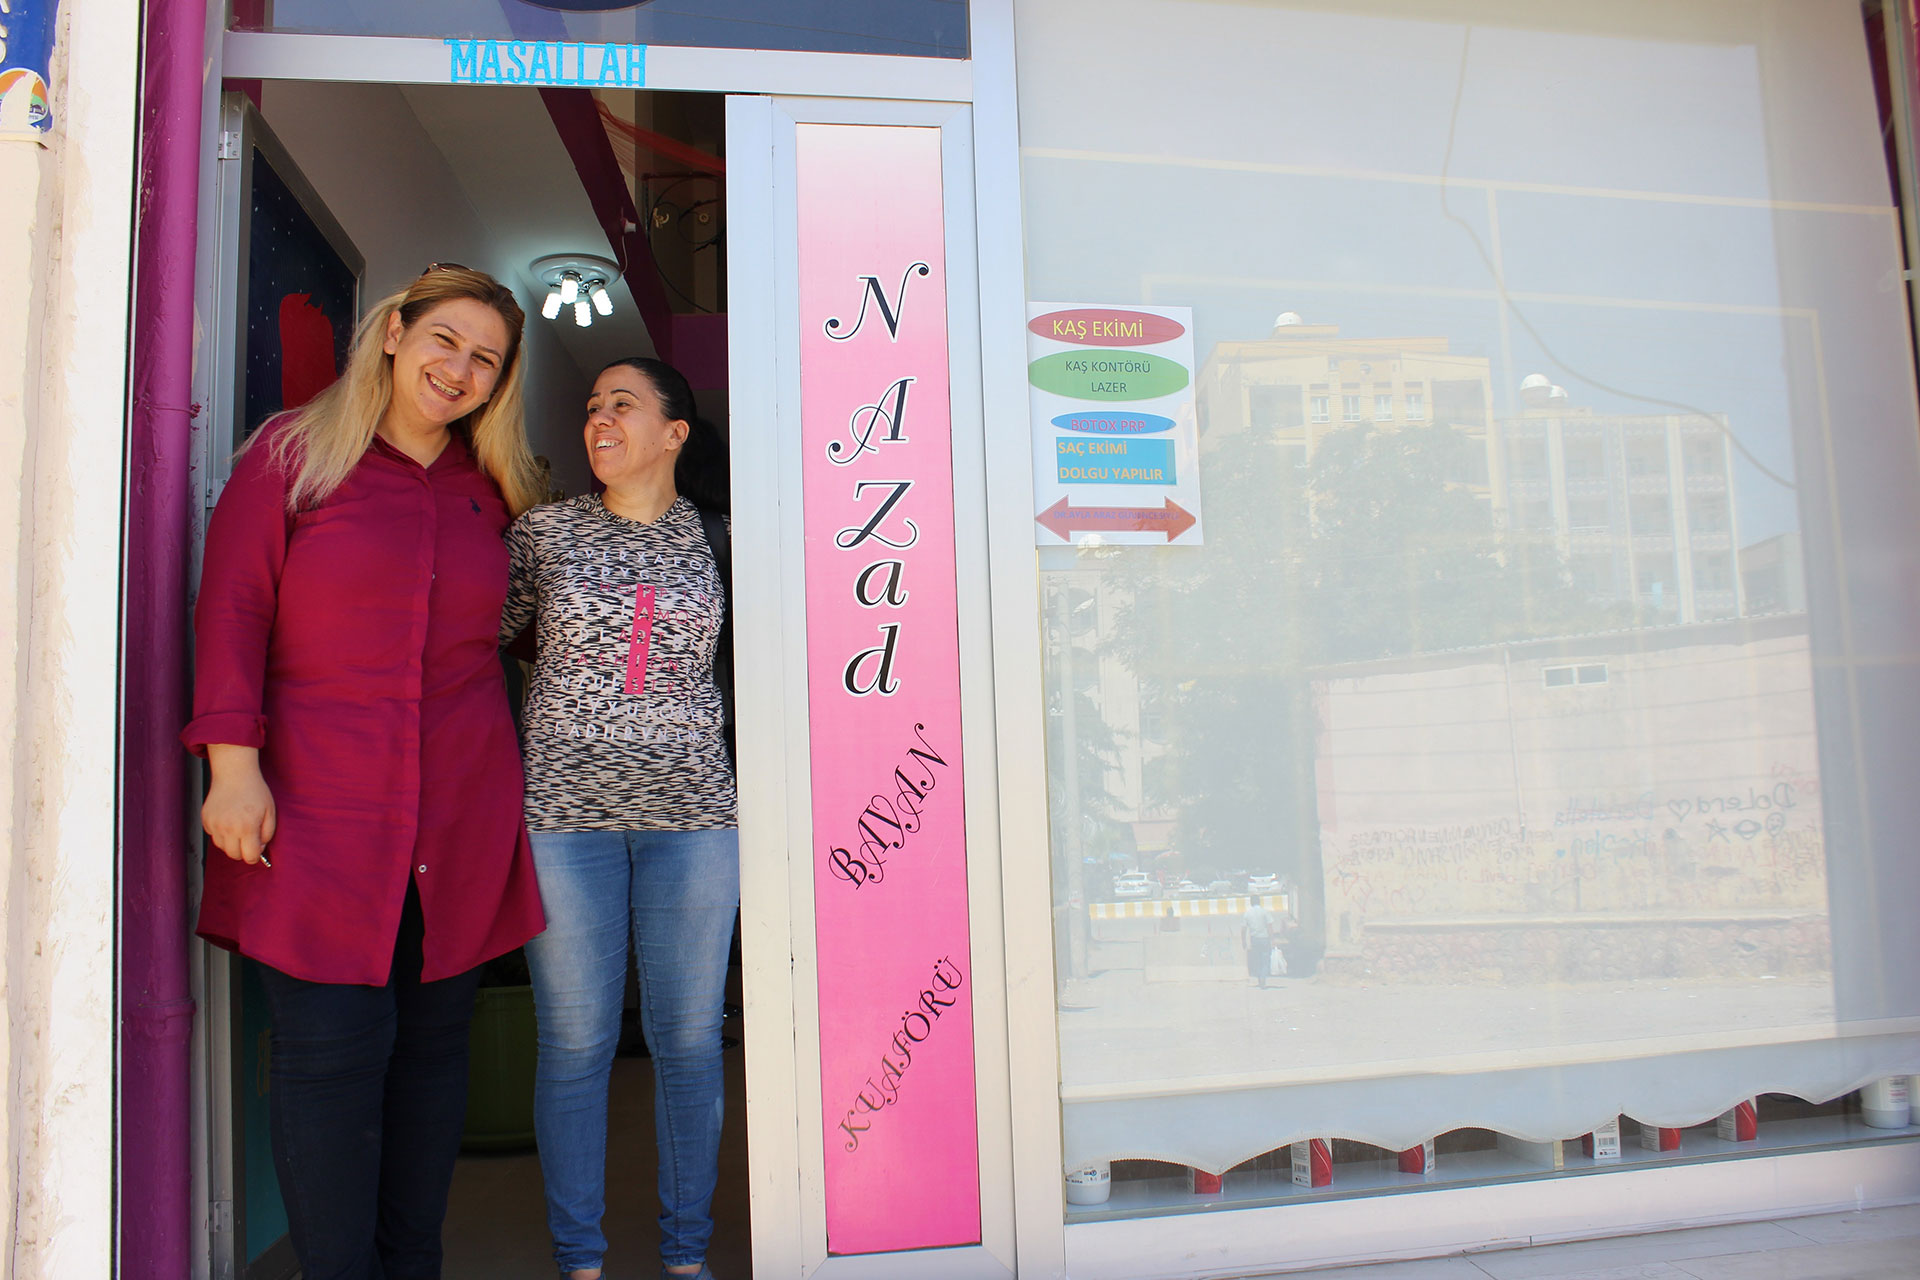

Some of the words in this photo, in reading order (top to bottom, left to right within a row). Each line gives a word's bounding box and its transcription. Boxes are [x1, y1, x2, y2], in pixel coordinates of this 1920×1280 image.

[444, 39, 647, 87] MASALLAH
[1053, 319, 1087, 339] KAŞ
[1092, 318, 1144, 338] EKİMİ
[1065, 360, 1088, 374] KAŞ
[1091, 359, 1151, 373] KONTÖRÜ
[1091, 382, 1127, 393] LAZER
[1071, 419, 1117, 431] BOTOX
[1121, 420, 1146, 432] PRP
[1058, 442, 1085, 456] SAÇ
[1088, 440, 1128, 455] EKİMİ
[1059, 467, 1109, 479] DOLGU
[1112, 467, 1163, 480] YAPILIR
[828, 723, 949, 890] BAYAN
[838, 955, 963, 1153] KUAFÖRÜ
